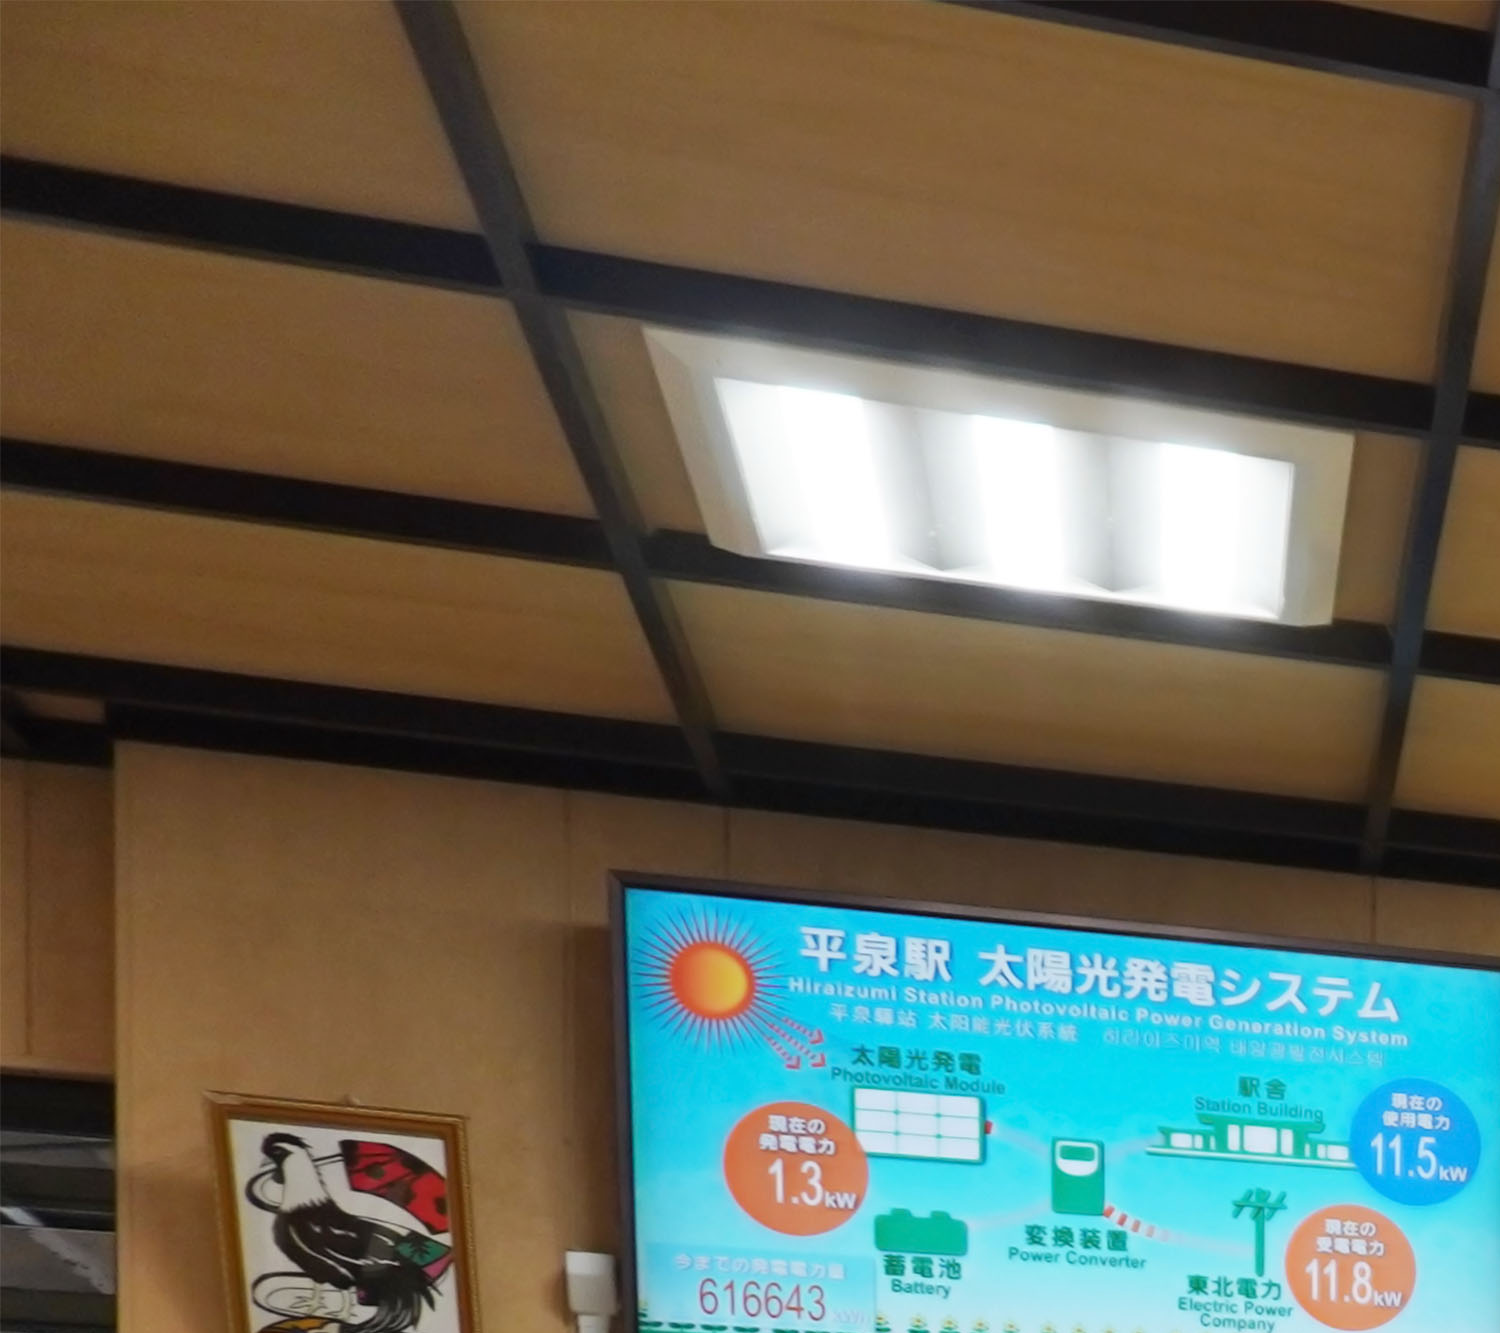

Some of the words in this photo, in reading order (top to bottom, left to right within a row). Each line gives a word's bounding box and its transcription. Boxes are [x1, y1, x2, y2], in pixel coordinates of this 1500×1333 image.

[801, 928, 953, 984] 平泉駅
[980, 945, 1400, 1023] 太陽光発電システム
[789, 976, 898, 1005] Hiraizumi
[905, 988, 983, 1011] Station
[991, 994, 1130, 1021] Photovoltaic
[1136, 1003, 1202, 1026] Power
[1209, 1012, 1326, 1040] Generation
[1332, 1024, 1409, 1048] System
[851, 1045, 983, 1078] 太陽光発電
[831, 1066, 939, 1091] Photovoltaic
[943, 1074, 1005, 1095] Module
[1238, 1076, 1288, 1100] 駅舎
[1194, 1096, 1251, 1117] Station
[1257, 1100, 1324, 1124] Building
[1391, 1091, 1443, 1113] 現在の
[767, 1114, 825, 1138] 現在の
[1382, 1110, 1451, 1132] 使用電力
[758, 1134, 836, 1156] 発電電力
[1025, 1225, 1129, 1253] 変換装置
[1325, 1219, 1377, 1240] 現在の
[1008, 1247, 1061, 1267] Power
[1065, 1251, 1148, 1271] Converter
[1316, 1237, 1385, 1258] 受電電力
[673, 1254, 848, 1281] 今までの発電電力量
[882, 1252, 962, 1282] 蓄電池
[698, 1276, 827, 1324] 616643
[891, 1276, 951, 1299] Battery
[1187, 1274, 1283, 1301] 東北電力
[1178, 1297, 1239, 1316] Electric
[1244, 1301, 1294, 1321] Power
